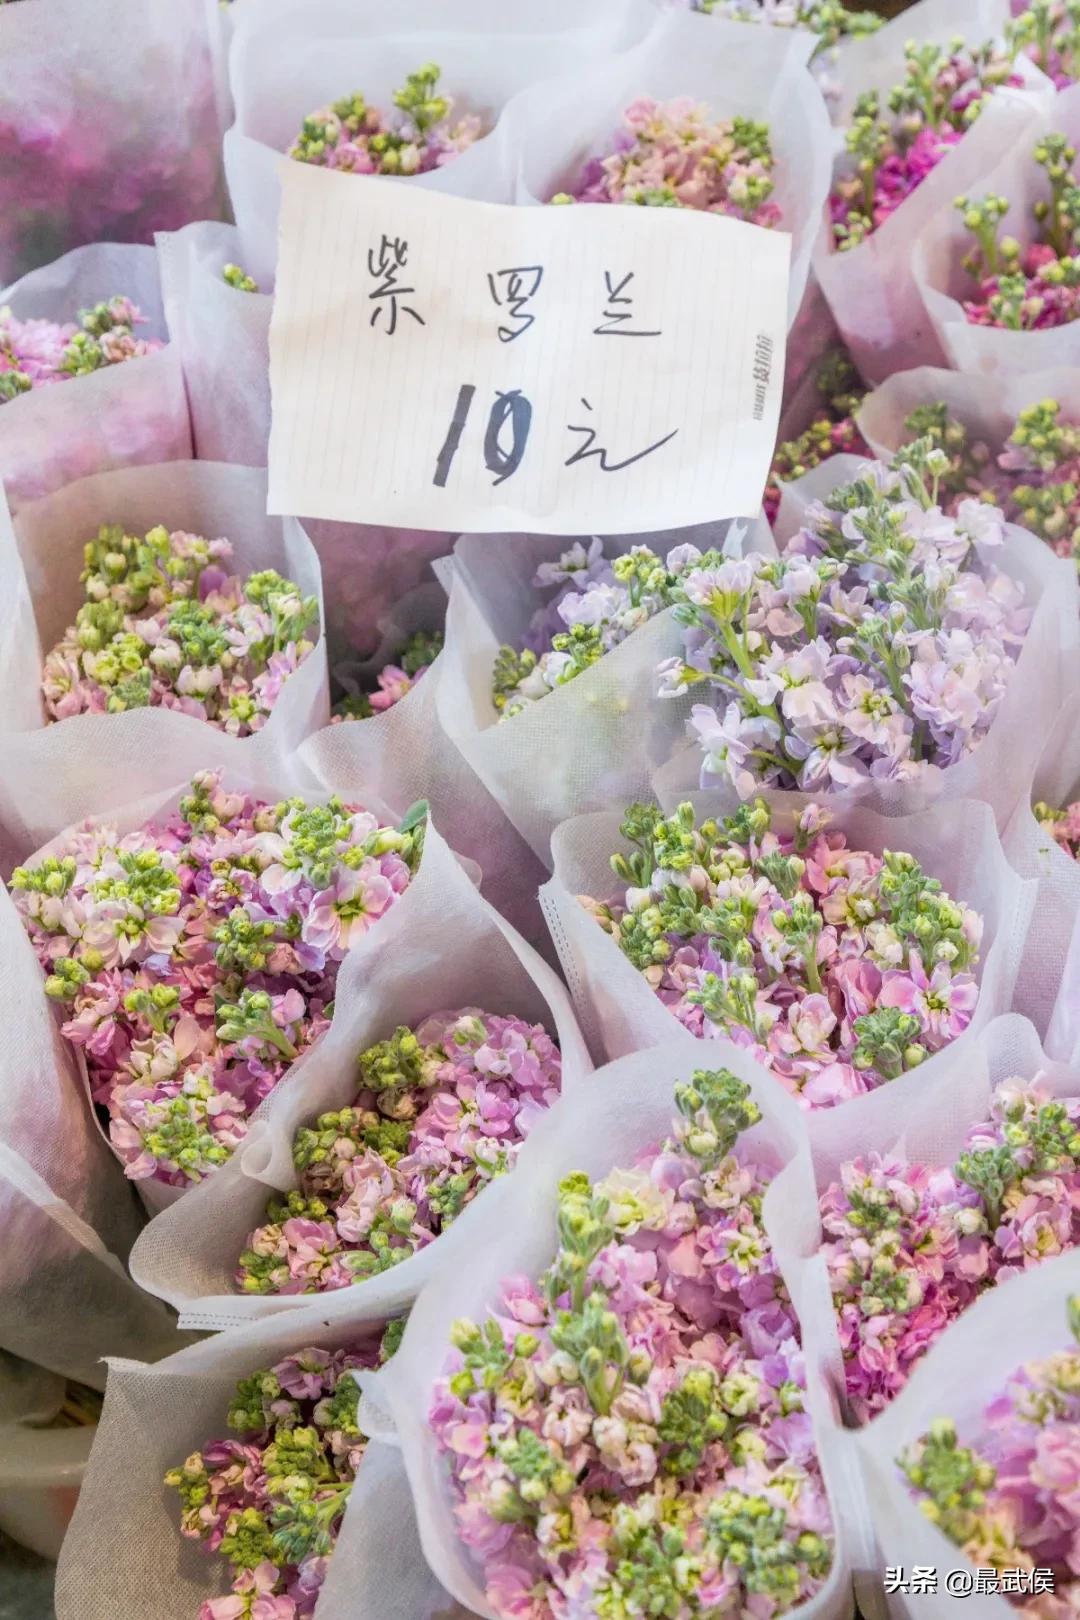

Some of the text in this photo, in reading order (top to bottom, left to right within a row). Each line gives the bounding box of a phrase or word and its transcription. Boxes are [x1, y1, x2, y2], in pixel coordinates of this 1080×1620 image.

[367, 235, 661, 342] 紫罗兰
[433, 385, 678, 487] 10元
